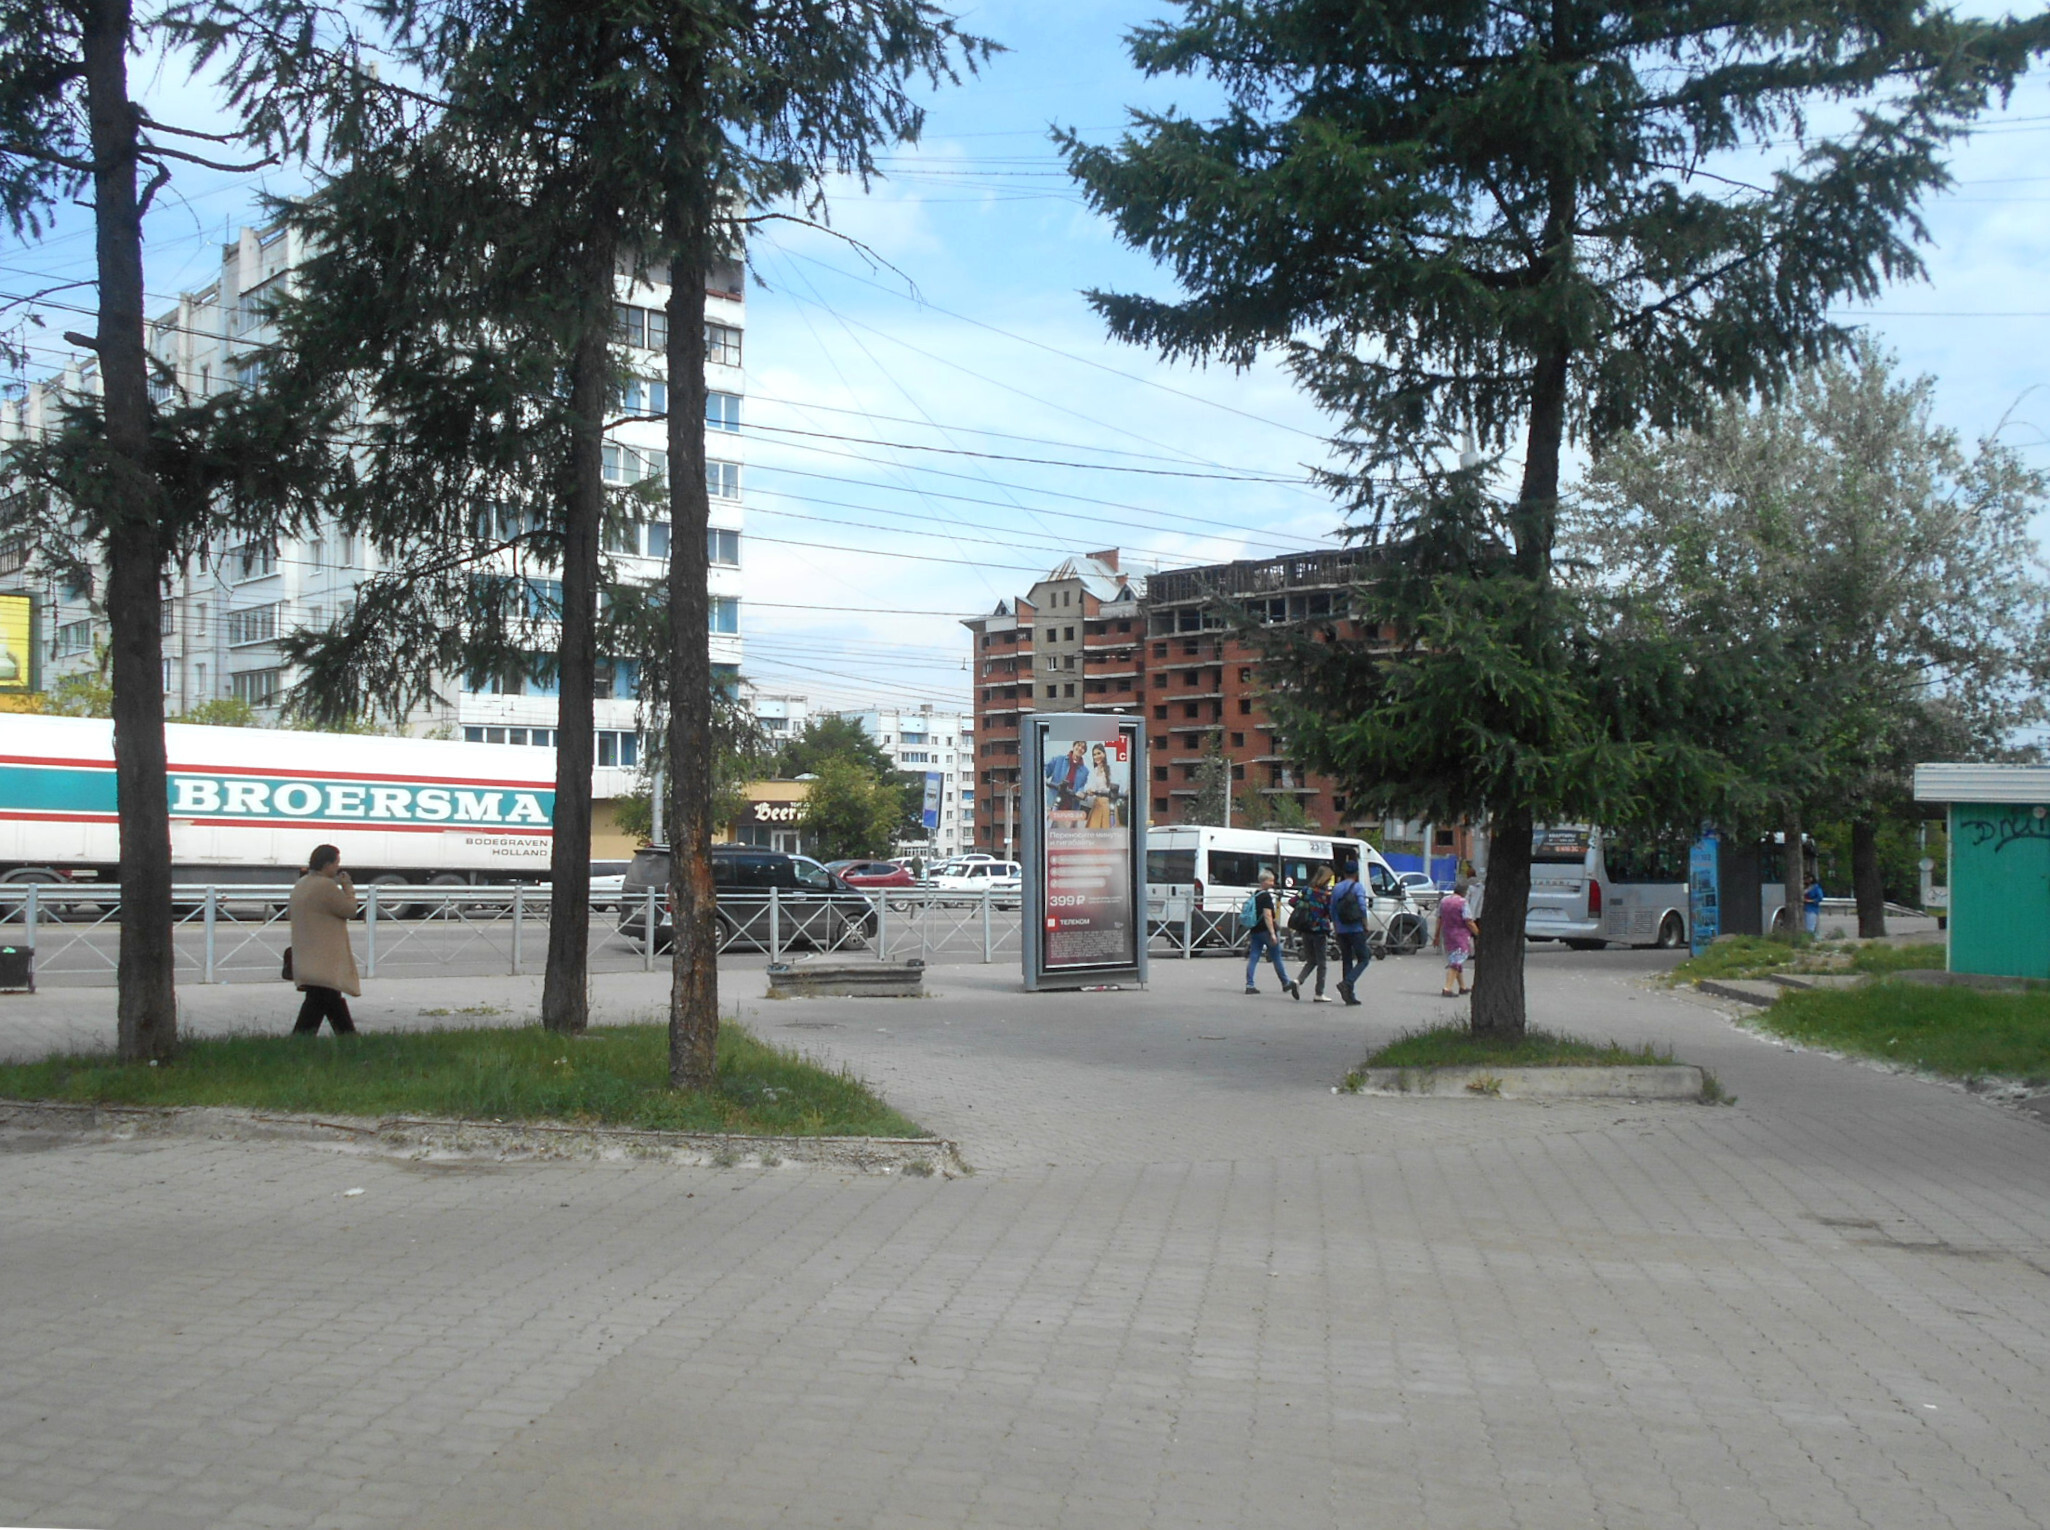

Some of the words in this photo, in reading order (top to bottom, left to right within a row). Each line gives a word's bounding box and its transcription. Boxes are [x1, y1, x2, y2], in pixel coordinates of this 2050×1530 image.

[173, 778, 549, 823] BROERSMA
[754, 802, 797, 821] Beer
[466, 838, 548, 846] BODEGRAVEN
[1059, 918, 1090, 926] ТЕЛЕКОМ
